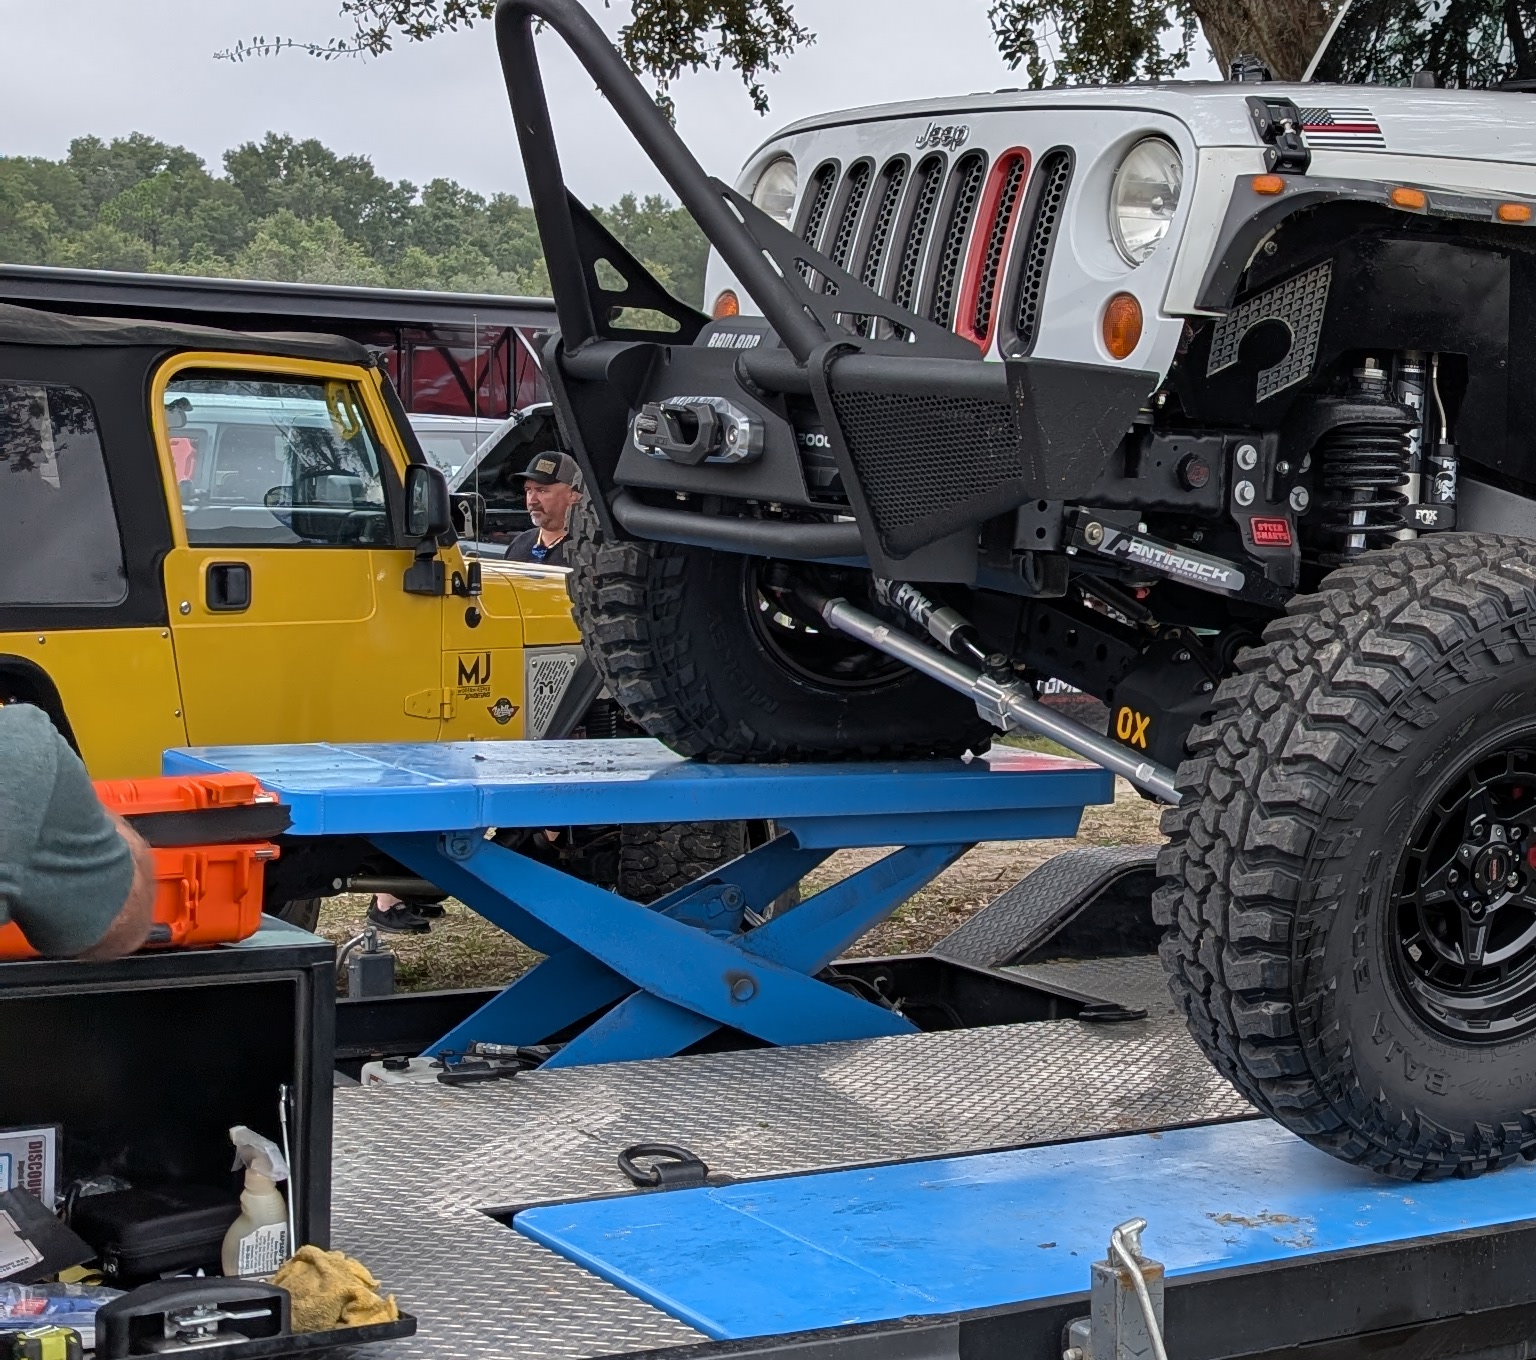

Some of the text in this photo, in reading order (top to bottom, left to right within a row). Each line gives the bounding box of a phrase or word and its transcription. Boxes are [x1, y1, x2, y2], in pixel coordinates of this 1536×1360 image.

[915, 121, 970, 152] Jeep
[1434, 459, 1458, 502] FOX
[1415, 509, 1439, 526] FOX
[1127, 541, 1230, 583] ANTIROCK
[457, 652, 491, 686] MJ
[1116, 706, 1151, 749] OX
